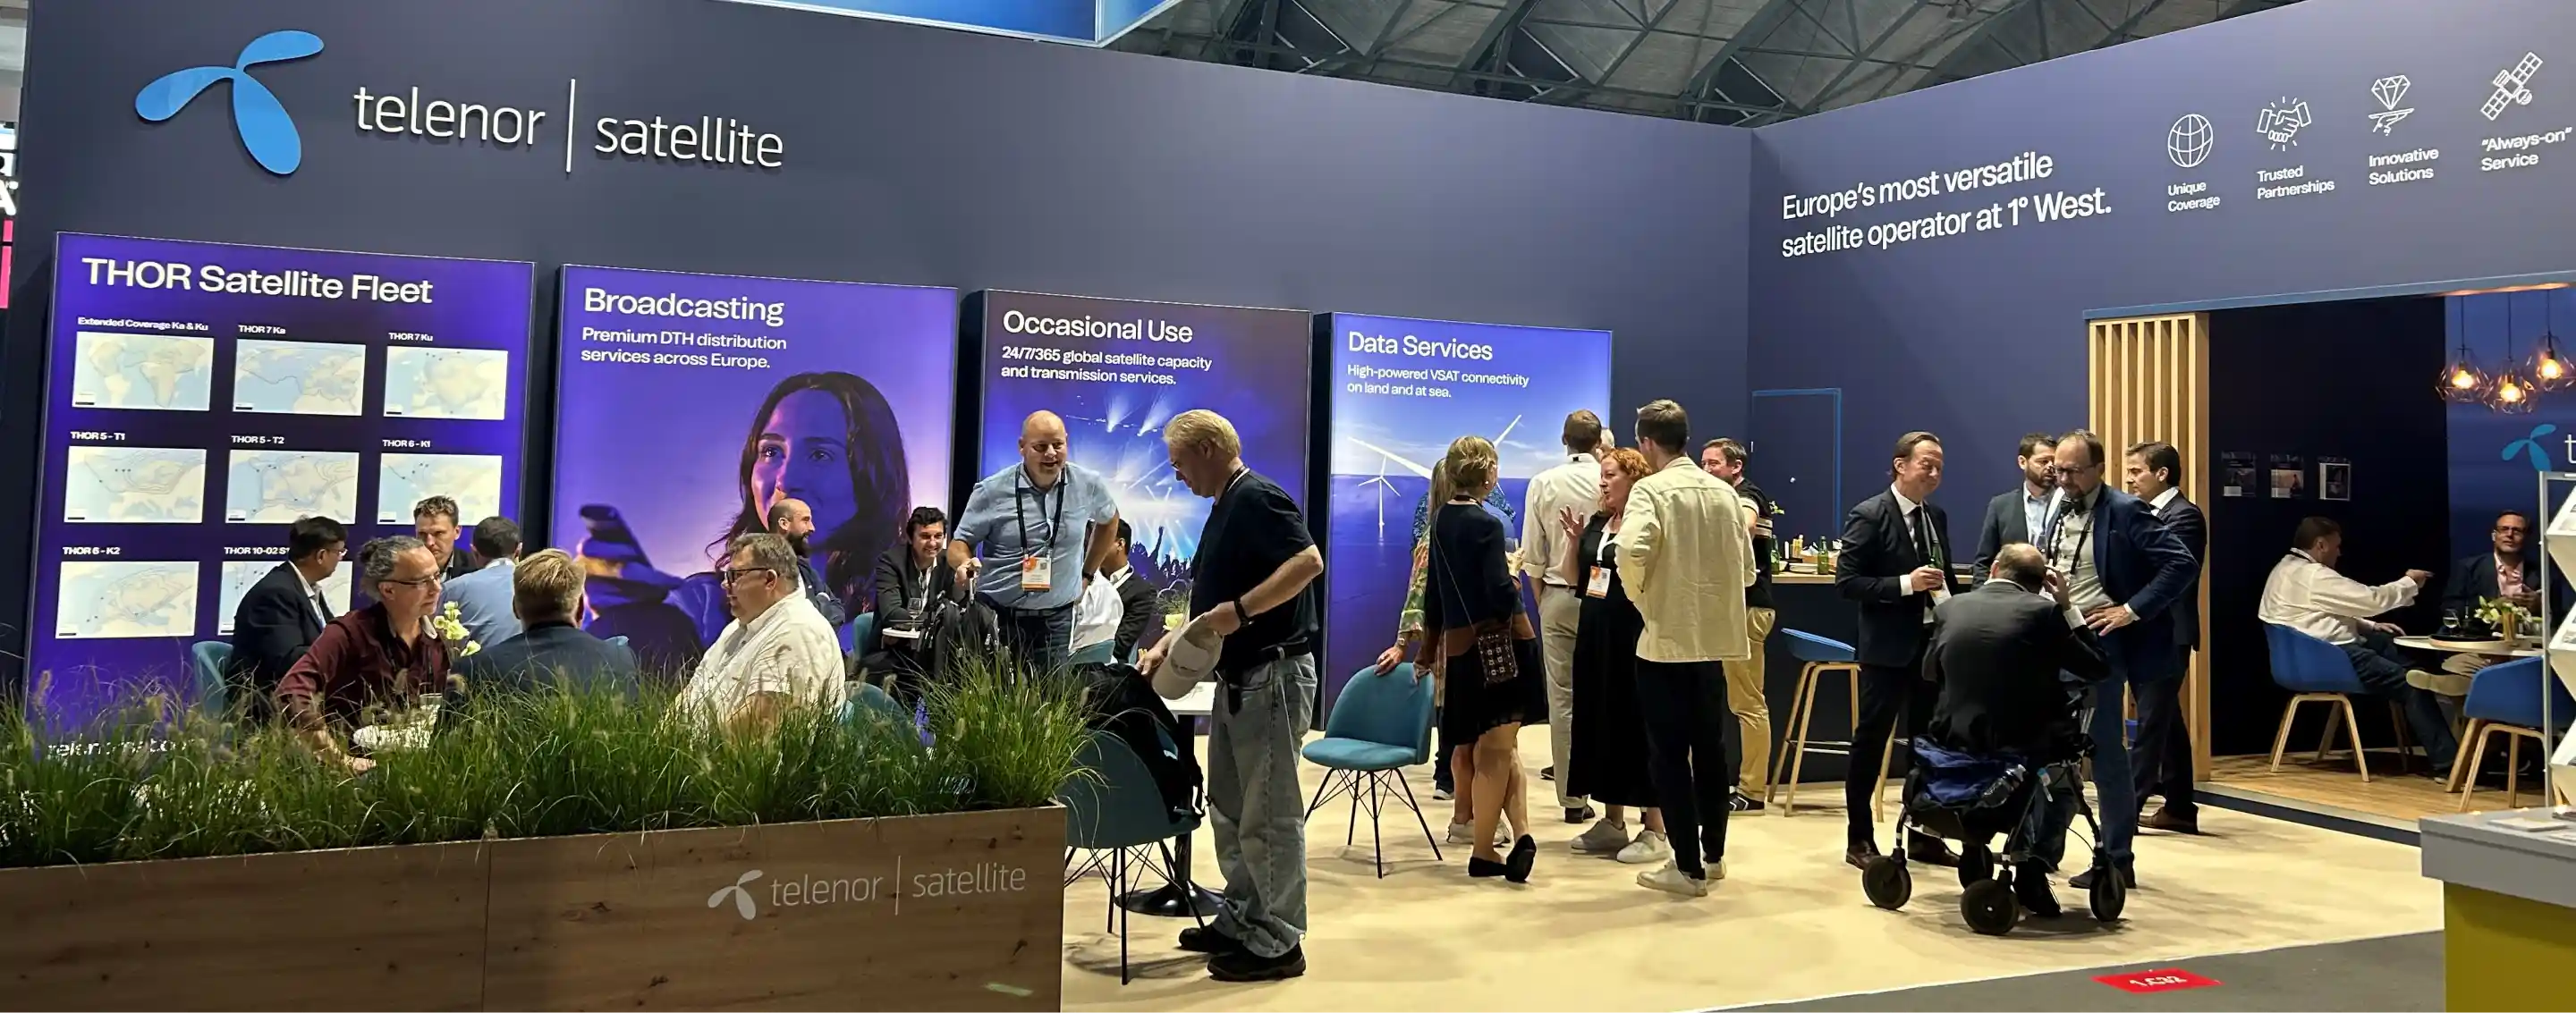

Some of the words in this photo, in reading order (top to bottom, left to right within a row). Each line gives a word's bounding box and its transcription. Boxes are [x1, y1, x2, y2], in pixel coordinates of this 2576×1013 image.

[353, 87, 546, 145] telenor
[595, 116, 783, 167] satellite
[2369, 148, 2439, 167] Innovative
[2481, 154, 2538, 171] Service
[1879, 171, 1939, 204] most
[1944, 151, 2053, 192] versatile
[2257, 165, 2303, 182] Trusted
[2369, 168, 2434, 185] Solutions
[2168, 182, 2207, 196] Unique
[2258, 179, 2335, 199] Partnerships
[2168, 197, 2220, 212] Coverage
[1782, 225, 1863, 257] satellite
[1868, 214, 1971, 249] operator
[1976, 203, 2003, 231] at
[2035, 187, 2112, 222] West.
[81, 257, 191, 290] THOR
[199, 266, 343, 299] Satellite
[352, 274, 433, 303] Fleet
[585, 288, 784, 326] Broadcasting
[78, 317, 123, 326] Extended
[125, 319, 171, 330] Coverage
[195, 323, 208, 331] Ku
[238, 325, 264, 333] THOR
[273, 326, 286, 334] Ka
[1004, 310, 1142, 340] Occasional
[1148, 319, 1193, 342] Use
[388, 333, 413, 341] THOR
[420, 333, 433, 342] Ku
[582, 327, 657, 343] Premium
[660, 331, 694, 345] DTH
[697, 333, 786, 350] distribution
[1349, 331, 1398, 354] Data
[1402, 335, 1493, 360] Services
[581, 349, 650, 363] services
[653, 353, 708, 366] across
[711, 353, 770, 370] Europe.
[1002, 346, 1061, 361] 24/7/365
[1063, 350, 1103, 365] global
[1105, 353, 1156, 366] satellite
[1157, 357, 1212, 371] capacity
[1001, 366, 1029, 377] and
[1030, 367, 1117, 382] transmission
[1120, 371, 1176, 384] services.
[1348, 364, 1428, 380] High-powered
[1430, 369, 1460, 382] VSAT
[1462, 374, 1530, 388] connectivity
[1347, 383, 1362, 393] on
[1364, 382, 1389, 394] land
[1391, 384, 1412, 395] and
[1415, 386, 1425, 396] at
[1428, 388, 1452, 398] sea.
[71, 431, 97, 440] THOR
[231, 435, 258, 443] THOR
[273, 436, 284, 444] T2
[382, 439, 408, 447] THOR
[63, 546, 91, 554] THOR
[771, 874, 883, 906] telenor
[912, 862, 1026, 898] satellite
